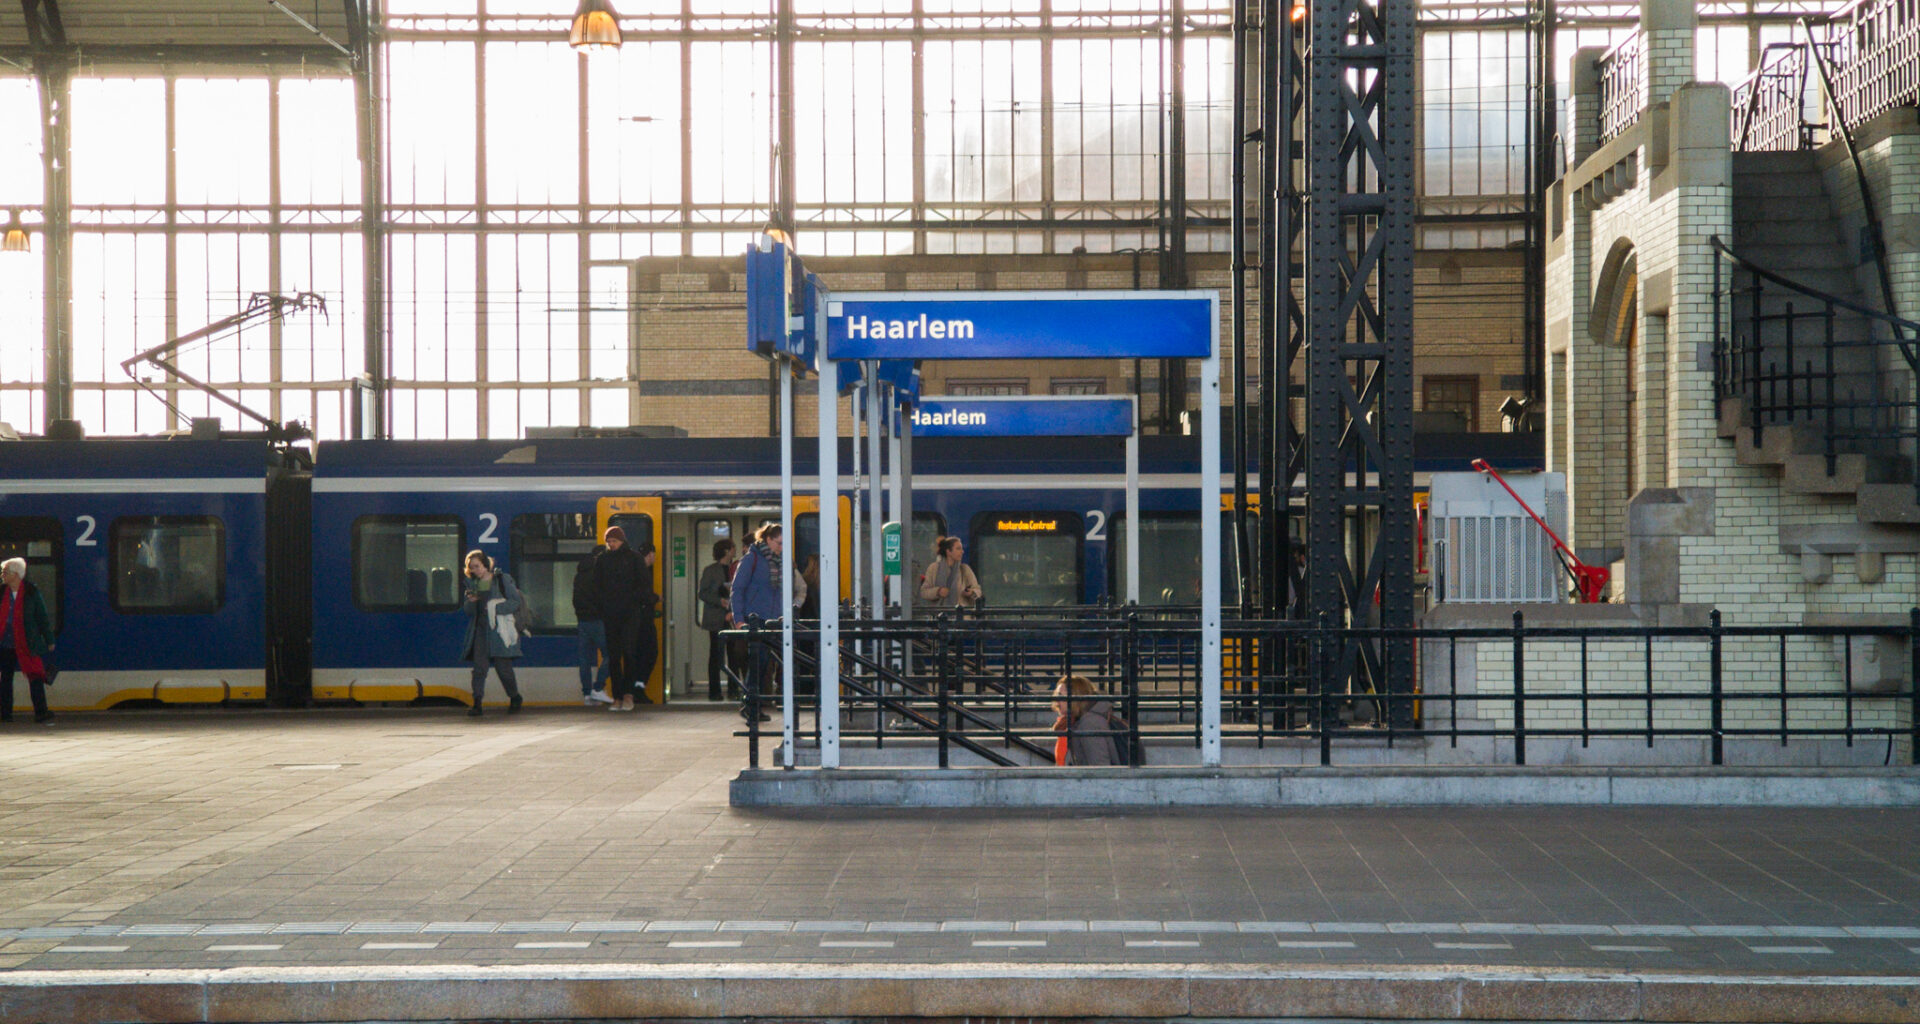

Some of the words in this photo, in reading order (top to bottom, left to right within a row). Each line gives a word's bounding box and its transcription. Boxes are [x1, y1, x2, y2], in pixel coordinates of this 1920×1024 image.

[847, 313, 974, 340] Haarlem
[911, 408, 987, 426] Haarlem
[76, 515, 97, 546] 2
[478, 512, 499, 543] 2
[1029, 520, 1056, 530] Centraal
[1085, 509, 1107, 541] 2
